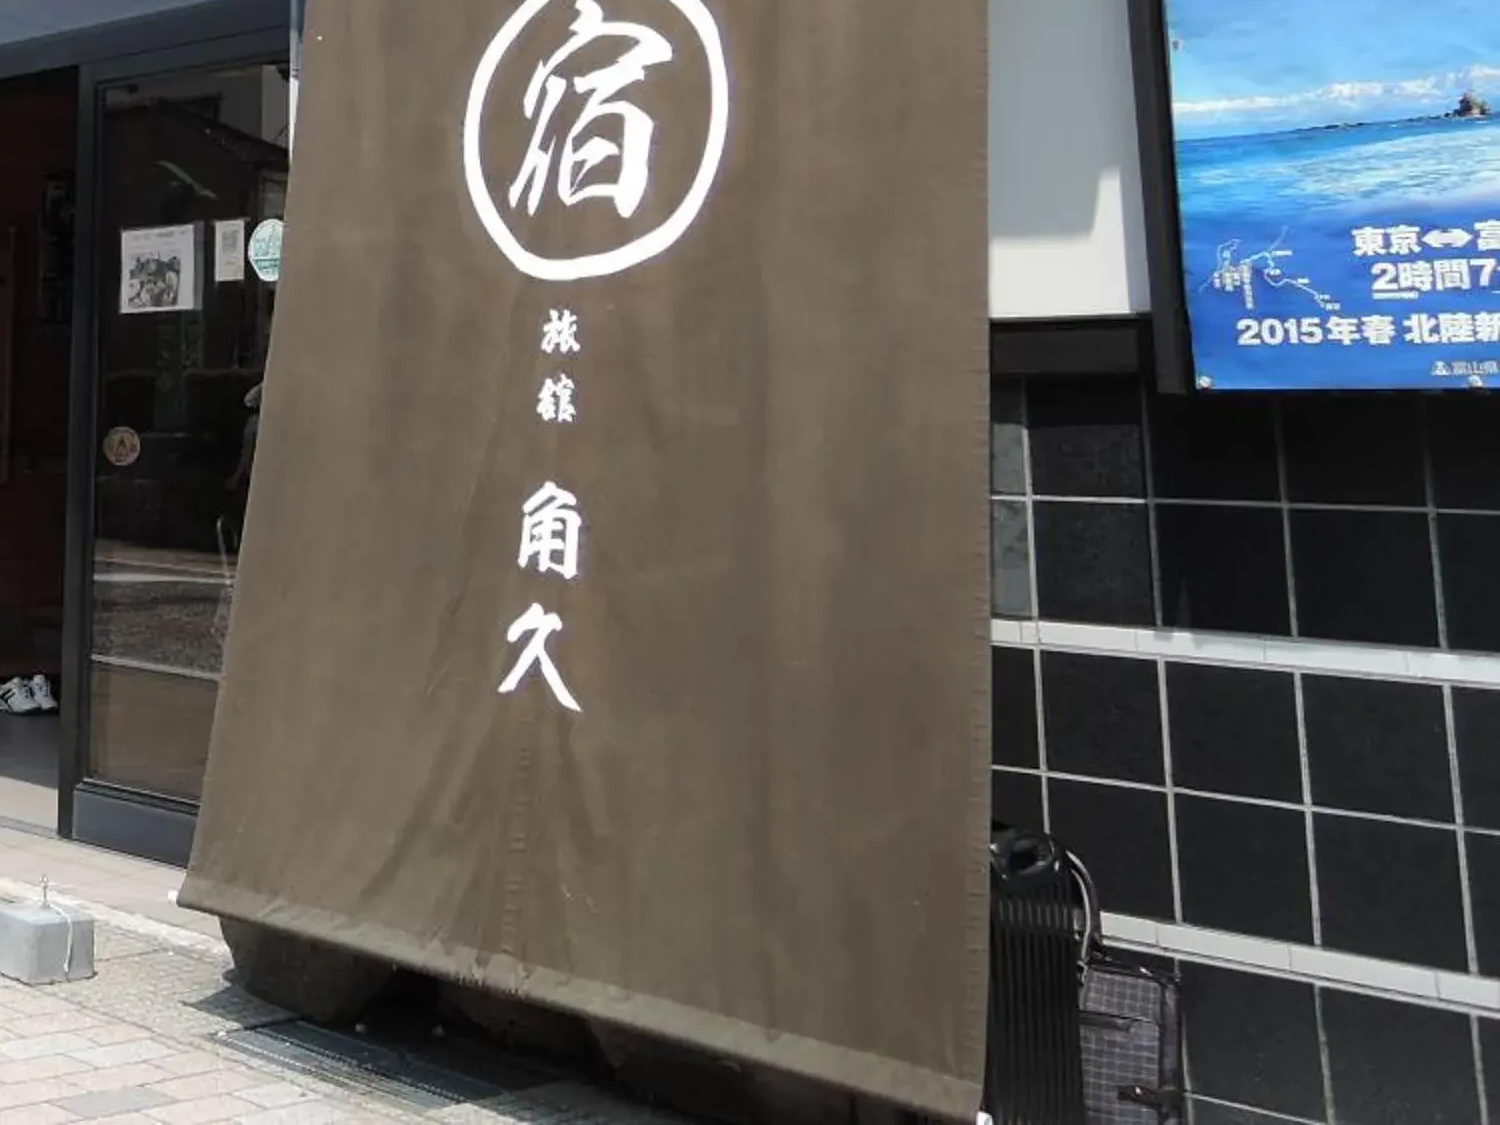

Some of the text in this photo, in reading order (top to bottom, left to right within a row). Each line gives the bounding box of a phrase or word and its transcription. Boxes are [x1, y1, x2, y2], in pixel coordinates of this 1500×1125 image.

[1371, 258, 1500, 291] 2時間7
[1236, 315, 1396, 346] 2015年春
[498, 480, 583, 713] 角久
